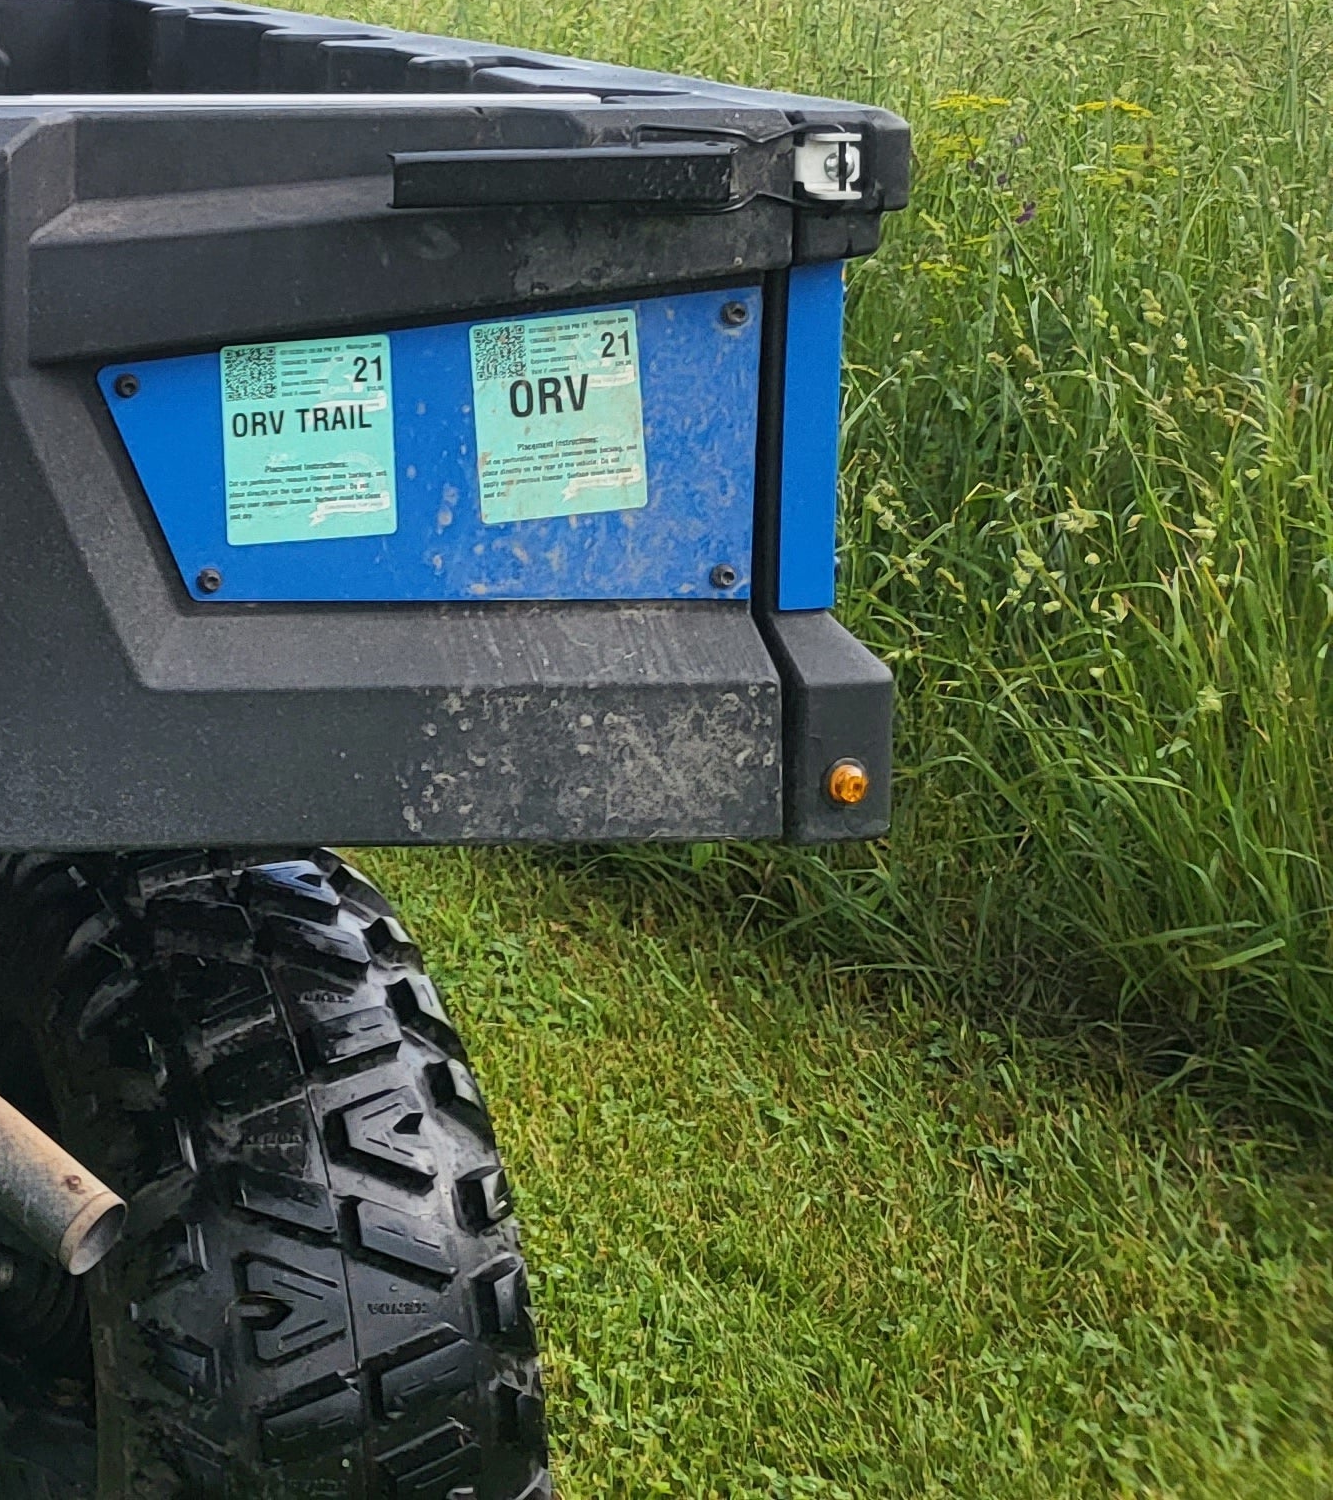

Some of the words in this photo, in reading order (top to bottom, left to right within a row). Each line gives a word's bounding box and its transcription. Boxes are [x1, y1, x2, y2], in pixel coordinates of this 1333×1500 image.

[600, 330, 630, 358] 21
[353, 356, 382, 382] 21
[509, 374, 588, 418] ORV
[233, 411, 285, 437] ORV
[295, 405, 372, 432] TRAIL
